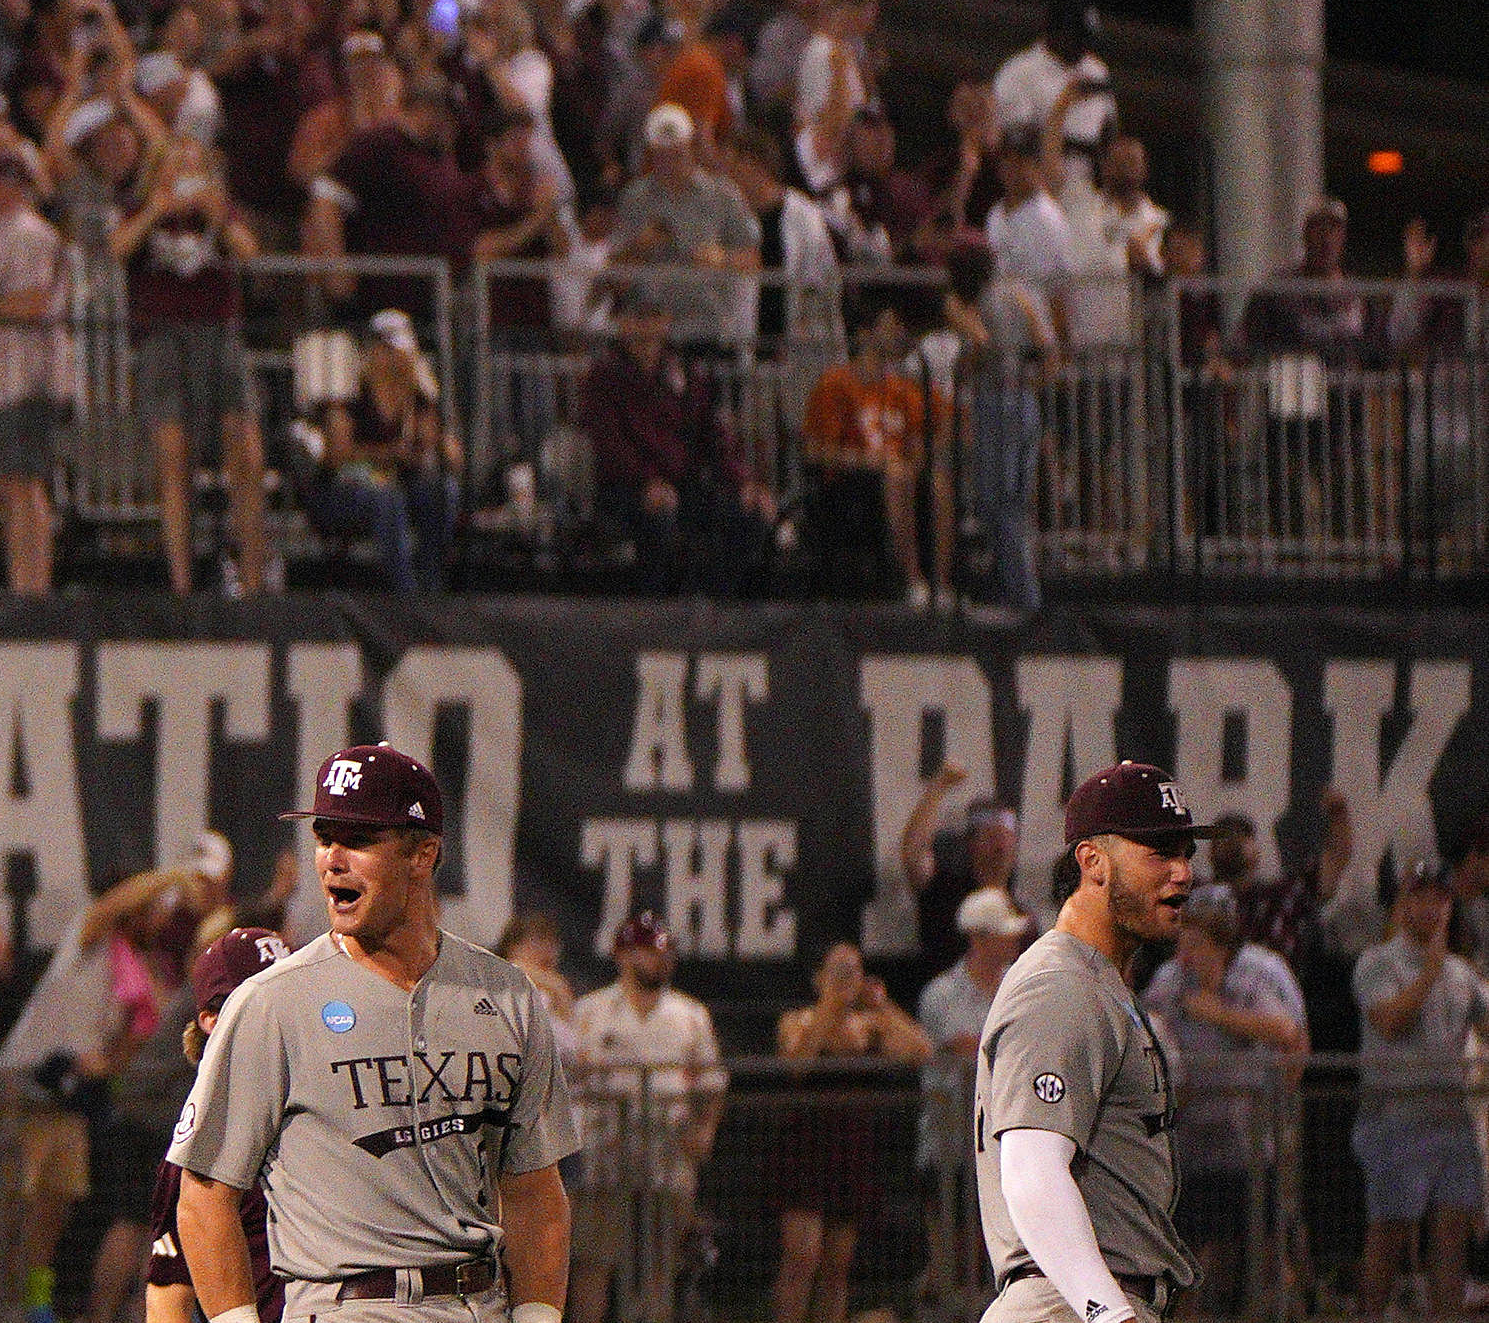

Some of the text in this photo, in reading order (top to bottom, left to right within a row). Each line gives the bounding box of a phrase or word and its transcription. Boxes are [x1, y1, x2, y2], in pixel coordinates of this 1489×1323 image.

[620, 650, 770, 794] AT
[858, 652, 1474, 962] PARK
[578, 817, 800, 961] THE
[330, 1051, 523, 1110] TEXAS
